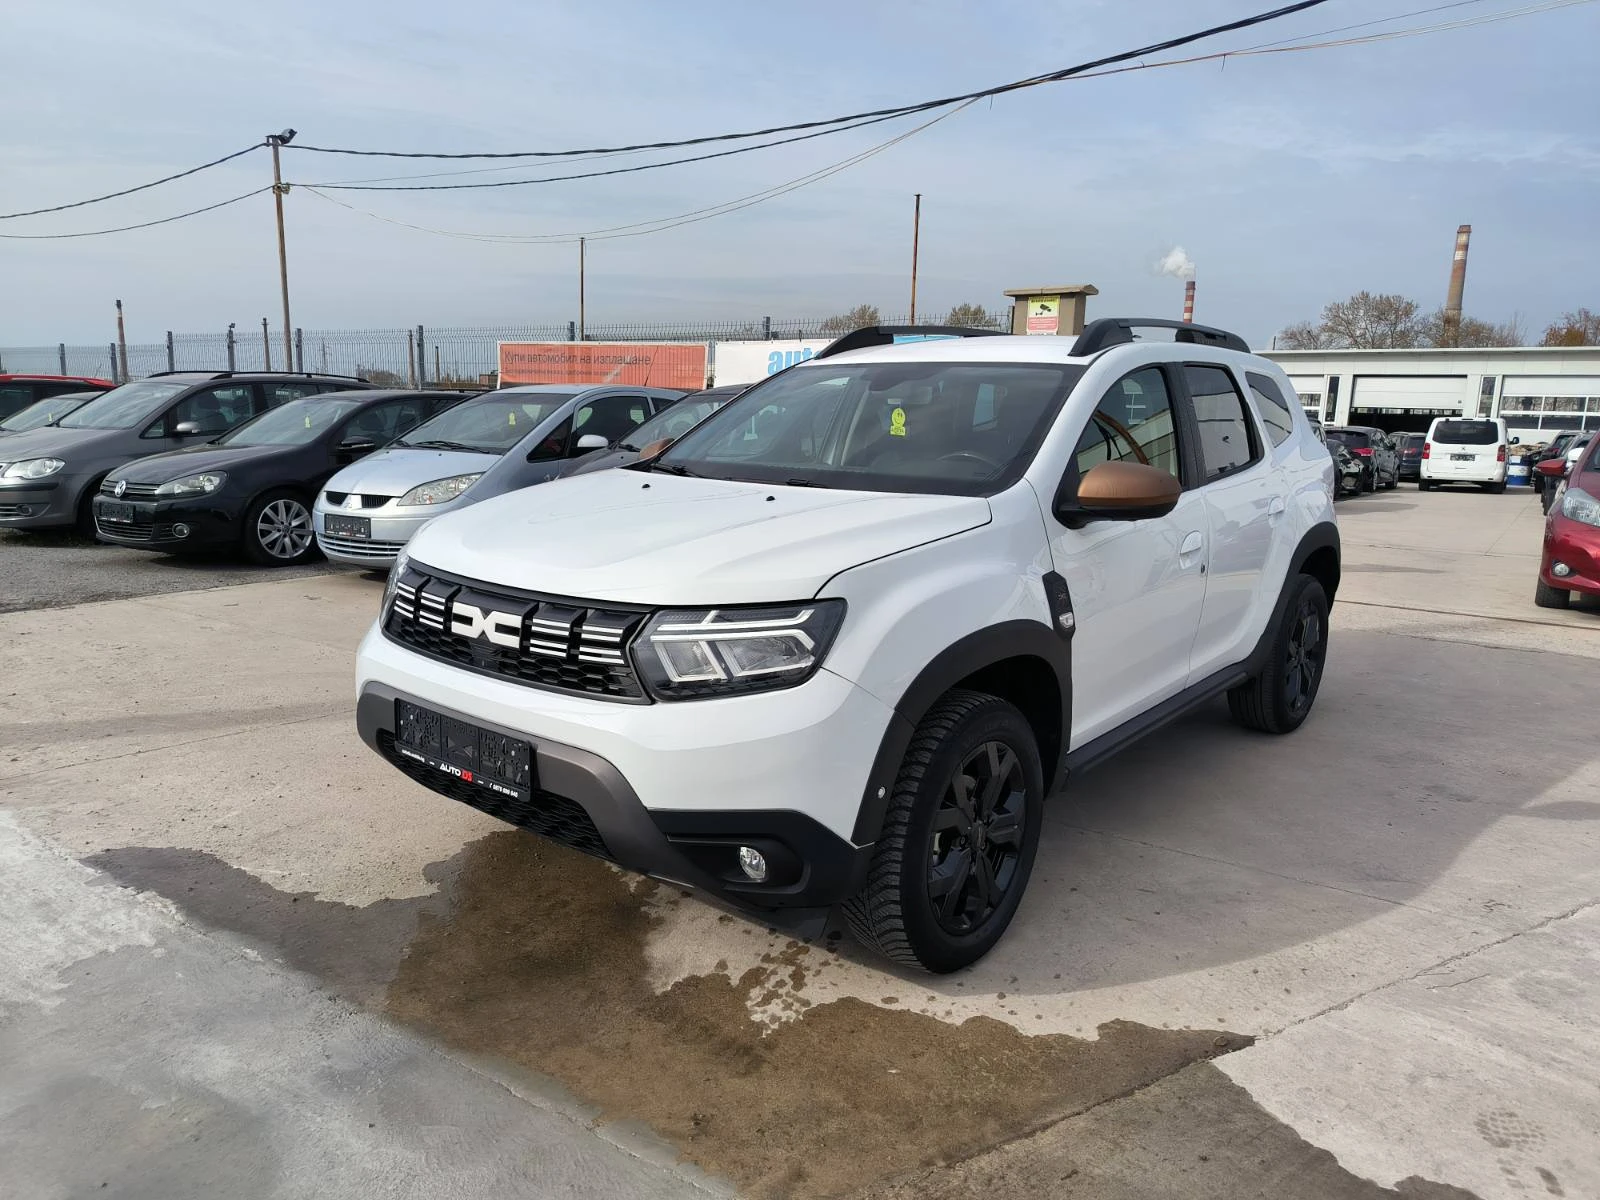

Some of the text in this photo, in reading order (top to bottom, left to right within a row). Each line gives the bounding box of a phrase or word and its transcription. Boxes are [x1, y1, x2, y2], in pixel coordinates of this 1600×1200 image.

[504, 351, 652, 366] Купи автомобил на изплащане
[439, 762, 461, 777] AUTO
